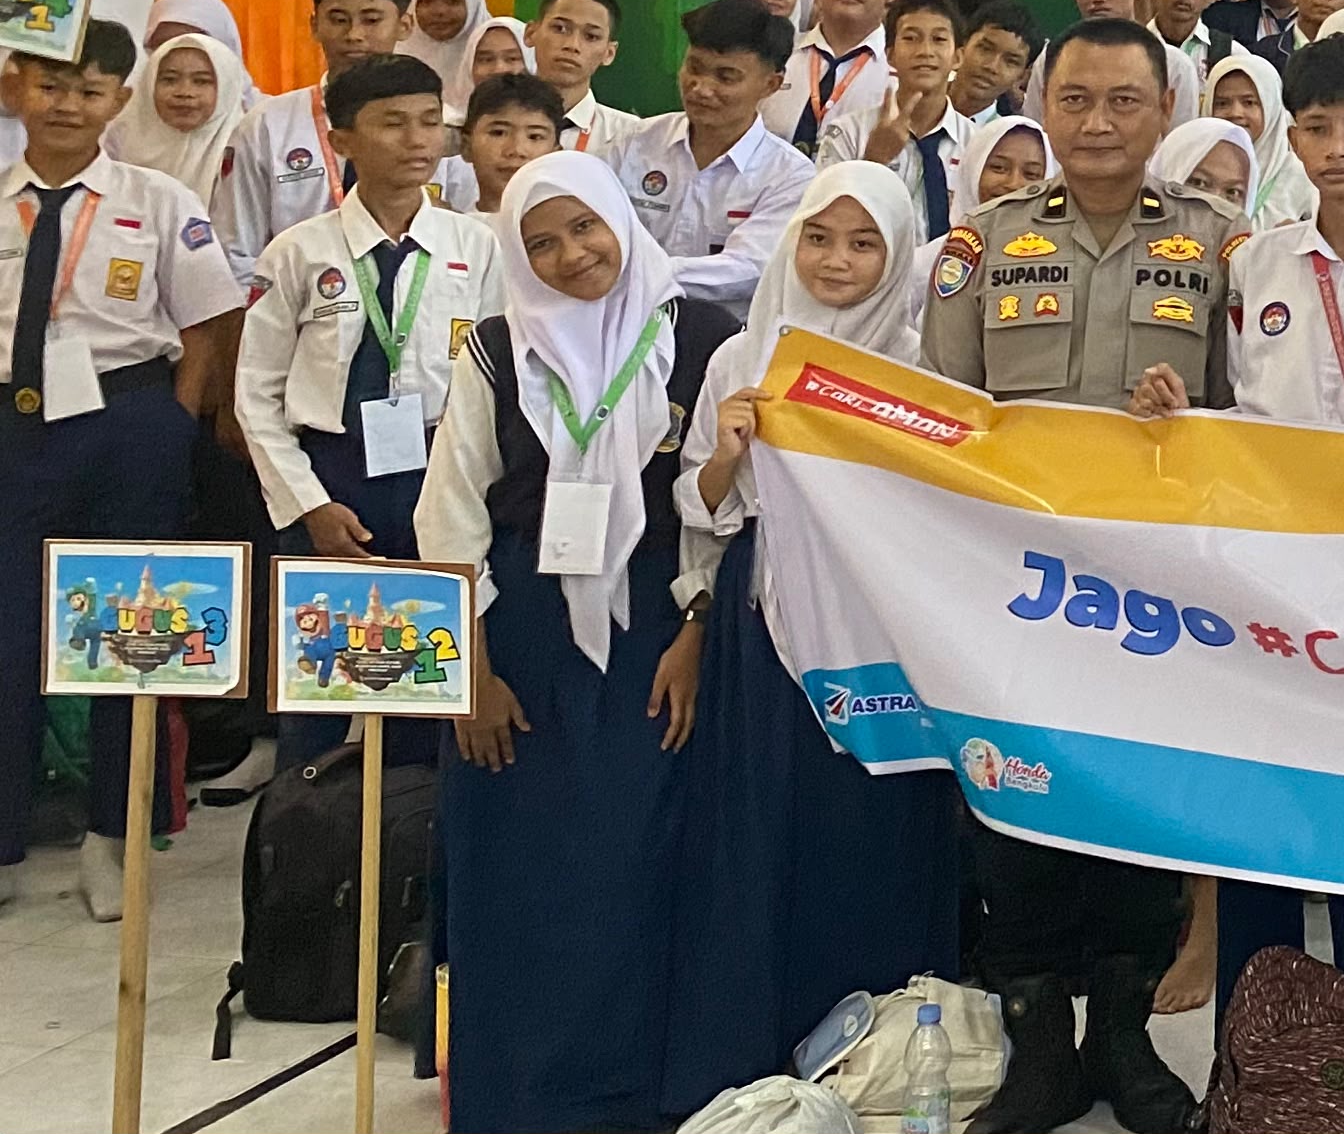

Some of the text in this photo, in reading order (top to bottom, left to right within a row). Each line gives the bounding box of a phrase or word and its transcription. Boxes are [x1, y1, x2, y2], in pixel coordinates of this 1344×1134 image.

[991, 265, 1069, 287] SUPARDI
[1136, 269, 1209, 295] POLRI
[1006, 550, 1236, 655] Jago
[850, 695, 917, 714] ASTRA
[1005, 757, 1051, 780] Honda
